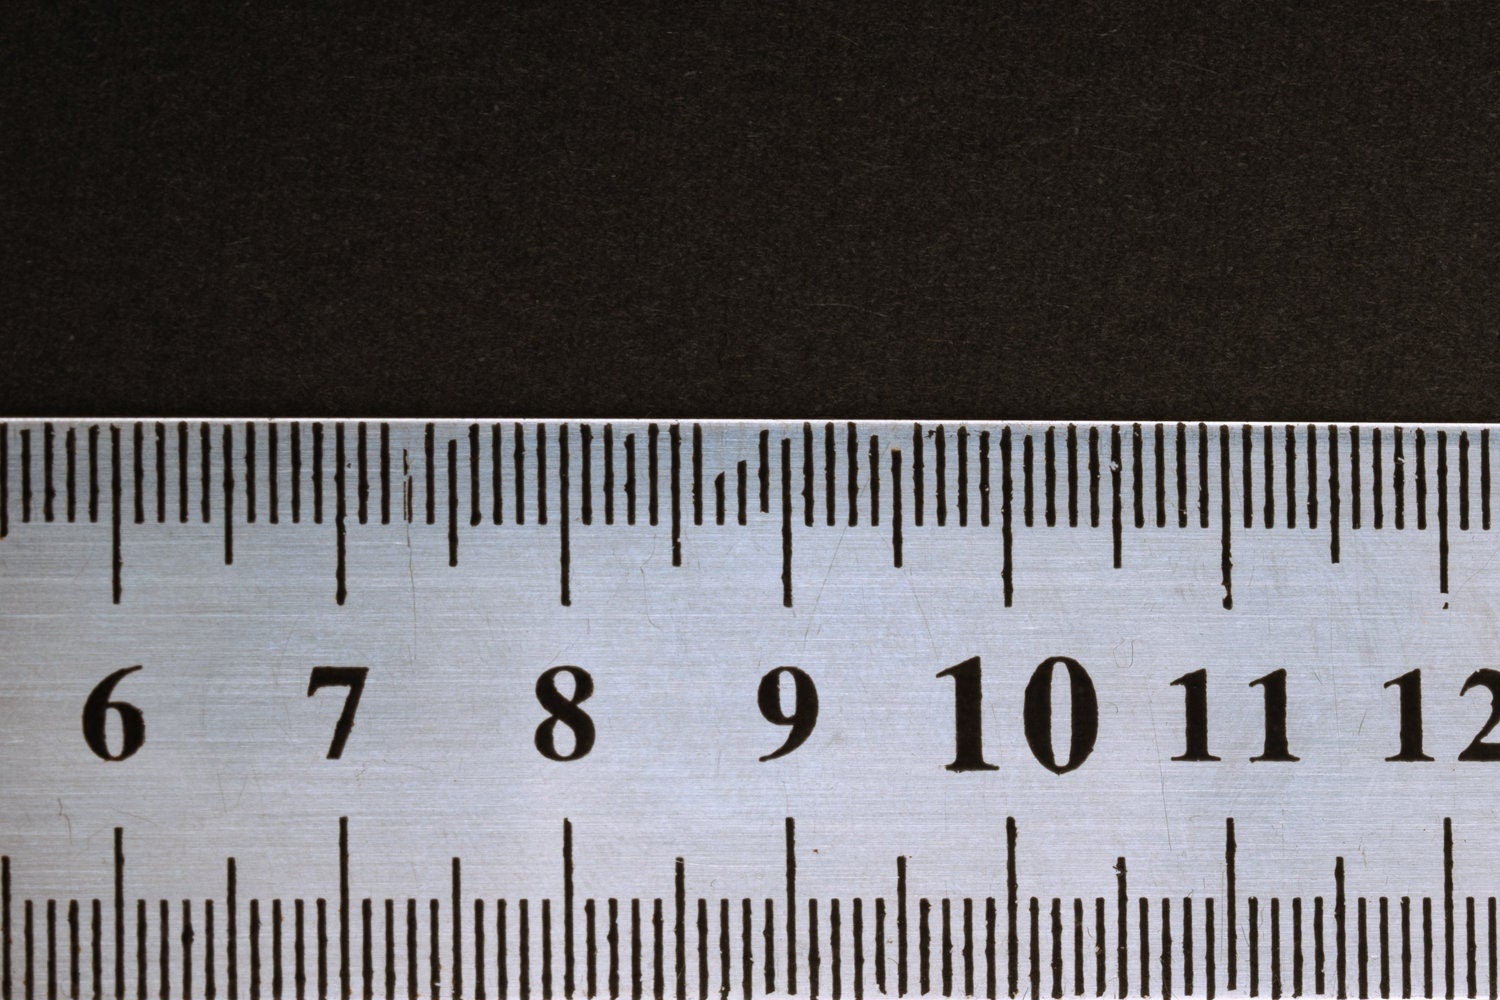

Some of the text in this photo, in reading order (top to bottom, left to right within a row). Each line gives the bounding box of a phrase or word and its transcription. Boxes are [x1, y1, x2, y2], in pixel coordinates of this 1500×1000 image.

[82, 664, 146, 762] 6
[307, 665, 370, 760] 7
[534, 665, 596, 762] 8
[757, 666, 819, 762] 9
[935, 655, 1099, 776] 10
[1169, 668, 1300, 763] 11
